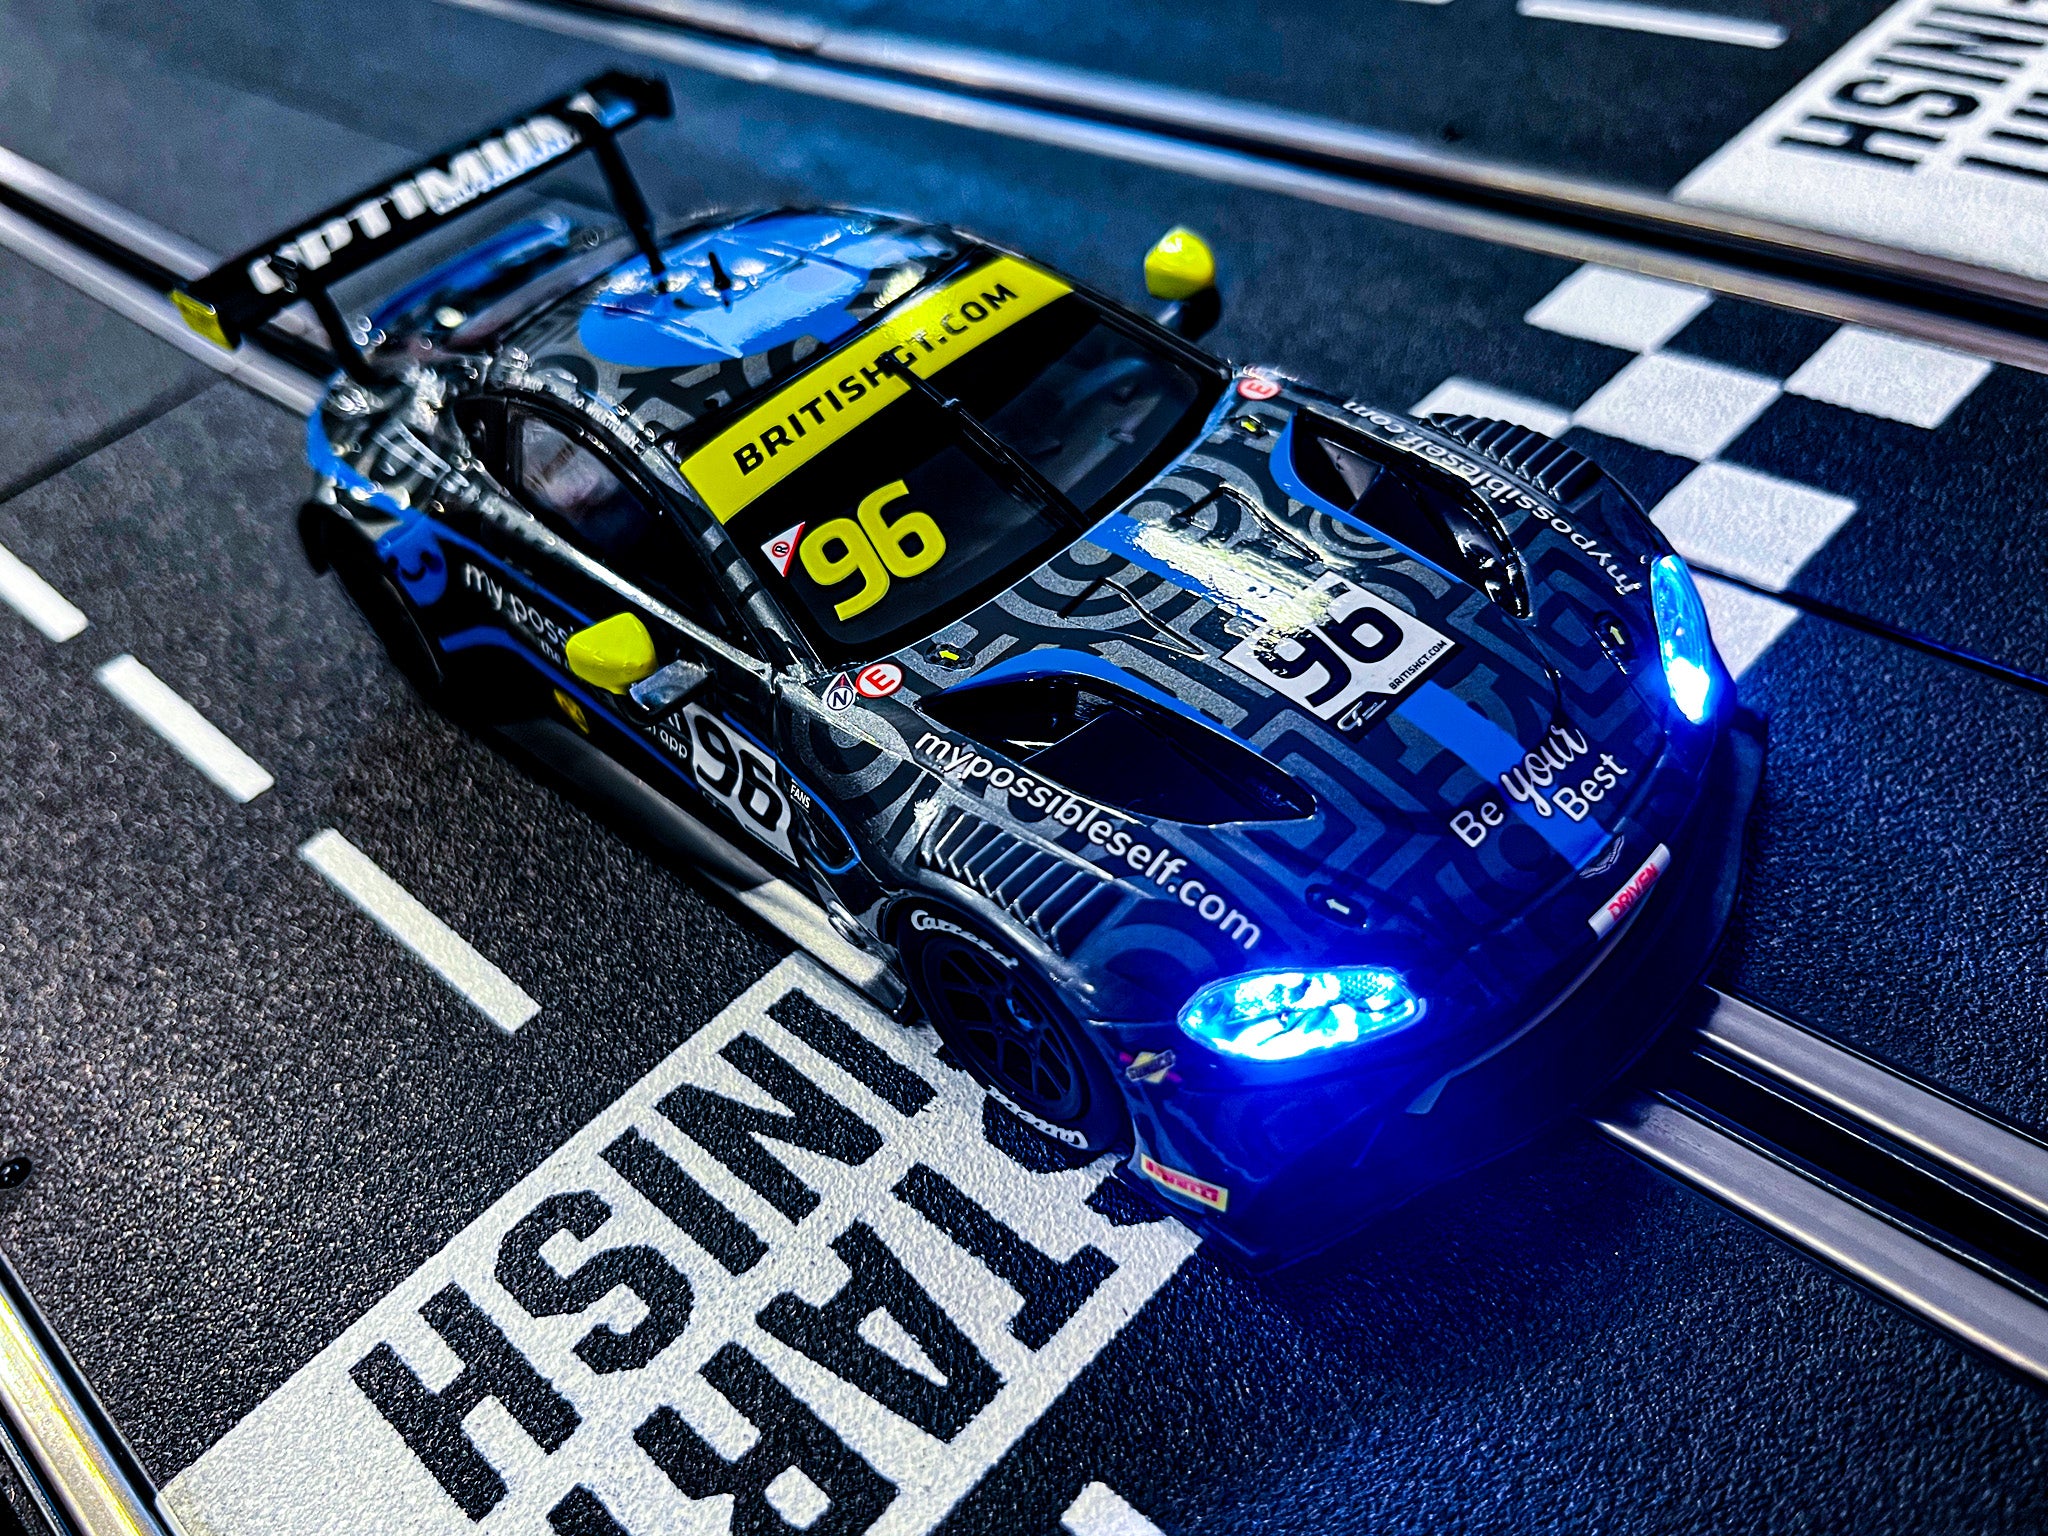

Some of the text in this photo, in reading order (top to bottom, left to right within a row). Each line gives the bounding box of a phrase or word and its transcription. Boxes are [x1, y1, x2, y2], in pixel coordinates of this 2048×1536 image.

[1779, 0, 2048, 171] INISH
[1246, 382, 1274, 395] E
[1341, 400, 1643, 596] mypossibleself.com
[775, 544, 789, 554] R
[798, 479, 947, 622] 96
[464, 562, 503, 612] my
[1253, 580, 1405, 709] 96
[1388, 639, 1448, 691] BRITISHGT.COM
[832, 689, 848, 708] N
[864, 668, 896, 692] E
[659, 730, 688, 759] app
[693, 714, 784, 833] 96
[789, 784, 811, 809] FANS
[1449, 724, 1589, 848] Be your
[1551, 752, 1628, 822] Best
[914, 731, 1262, 951] mypossibleself.com
[1606, 862, 1660, 922] DRIVEN
[910, 908, 1019, 970] Carrera
[347, 984, 958, 1523] INISH
